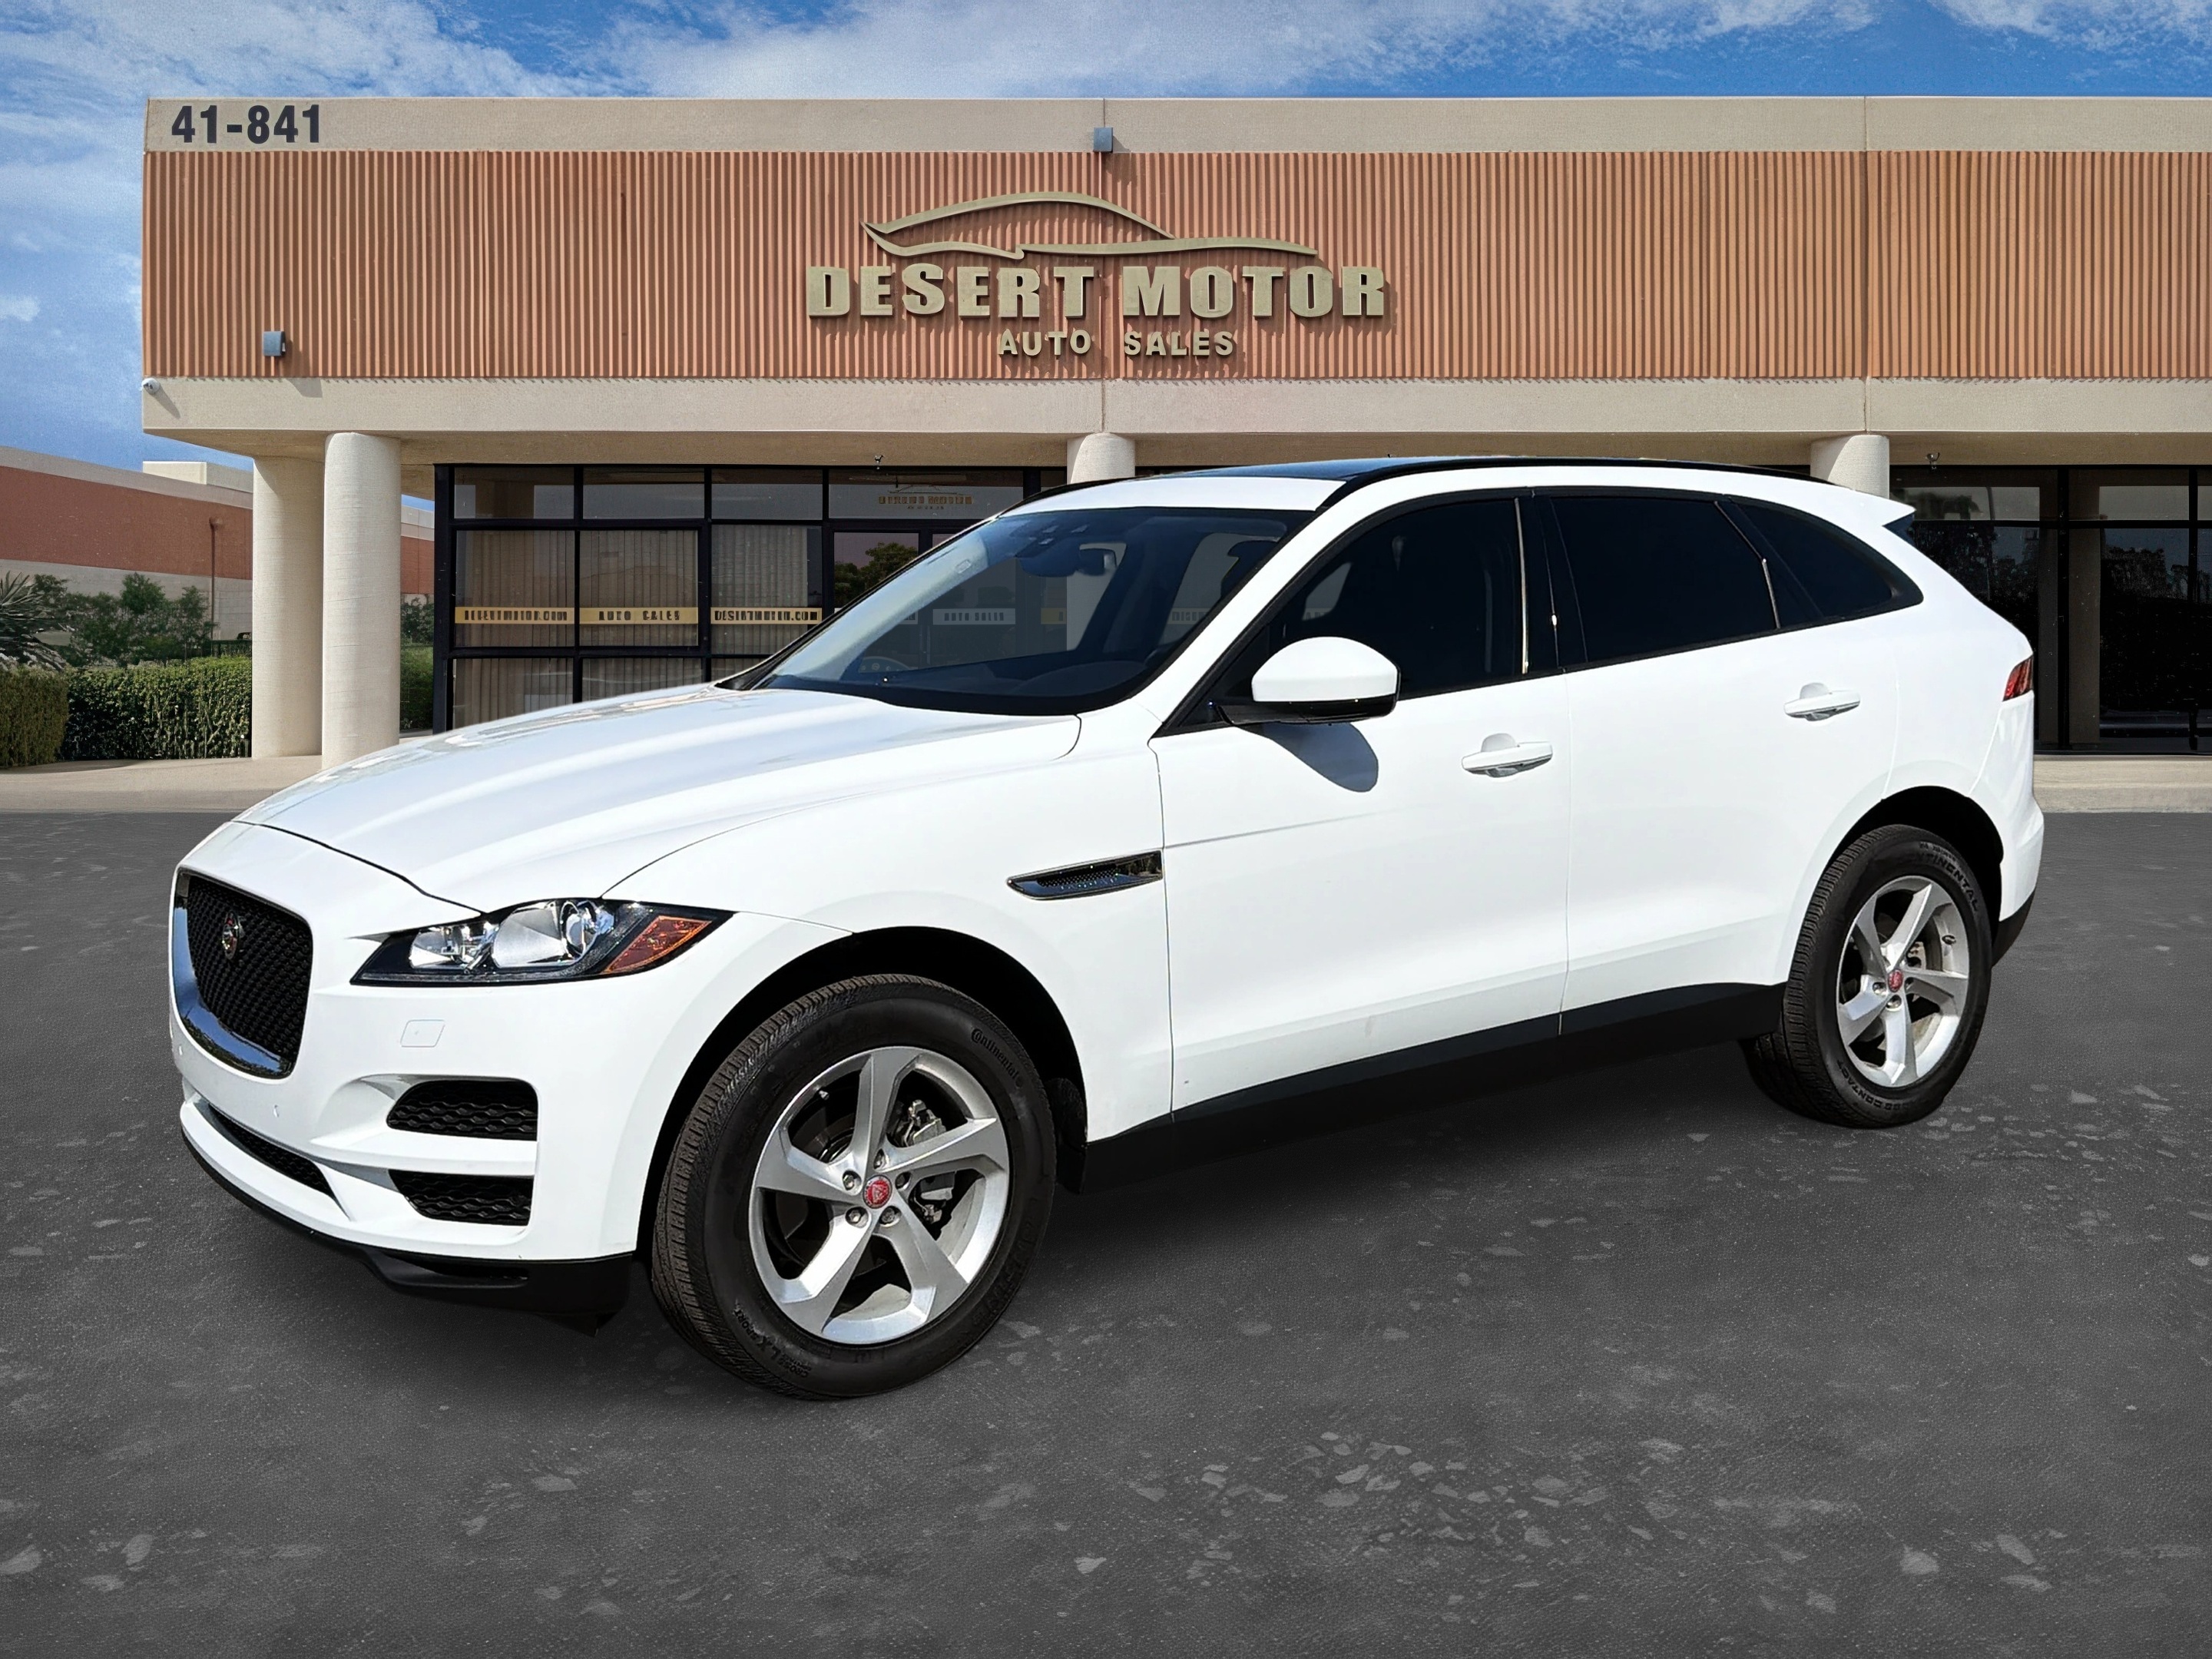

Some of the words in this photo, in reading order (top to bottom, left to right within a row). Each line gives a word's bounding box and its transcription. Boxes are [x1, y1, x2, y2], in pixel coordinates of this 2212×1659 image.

[171, 104, 320, 144] 41-841
[806, 263, 1094, 319] DESERT
[1122, 265, 1385, 319] MOTOR
[998, 329, 1091, 356] AUTO
[1124, 331, 1233, 356] SALES
